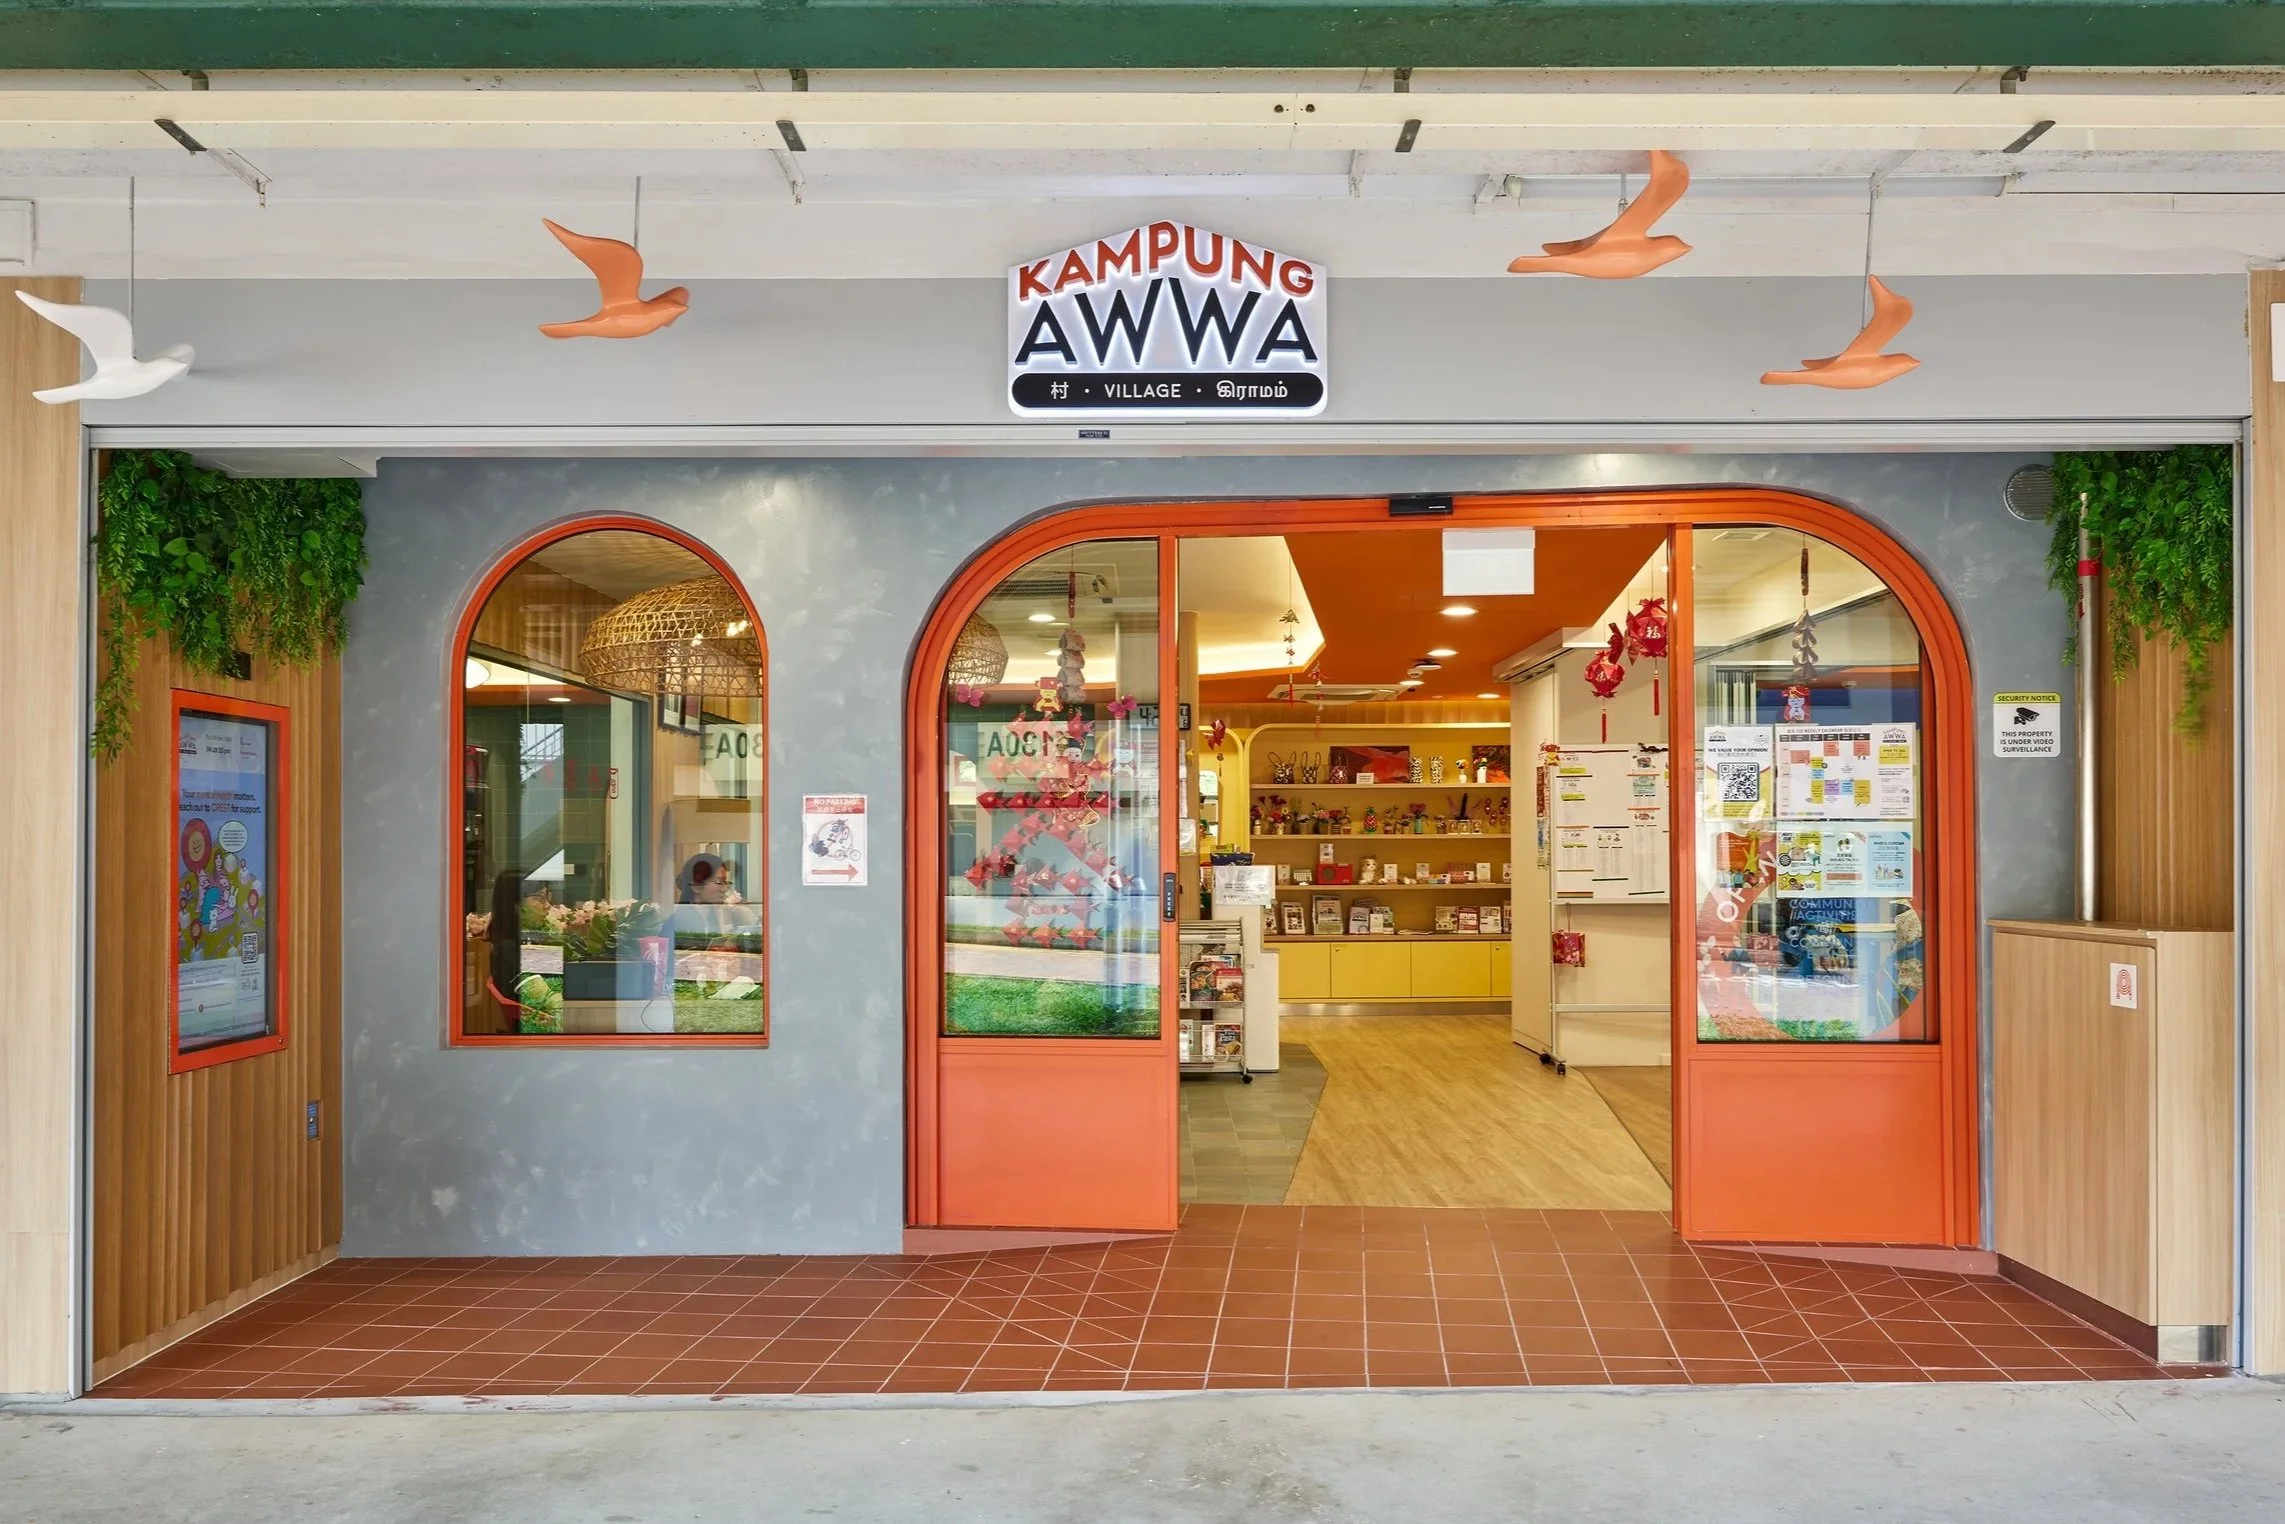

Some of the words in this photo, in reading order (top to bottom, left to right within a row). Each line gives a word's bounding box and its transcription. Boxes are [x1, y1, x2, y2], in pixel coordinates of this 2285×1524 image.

[1018, 220, 1315, 301] KAMPUNG
[1014, 277, 1318, 365] AWWA
[1051, 382, 1069, 400] 村
[1104, 383, 1182, 398] VILLAGE
[1216, 379, 1288, 401] கிராமம்
[1646, 626, 1661, 639] 福
[182, 789, 195, 800] Your
[179, 802, 193, 812] each
[231, 803, 239, 813] for
[1717, 850, 1777, 923] OPN
[1789, 898, 1865, 909] COMMUN
[1796, 910, 1859, 920] ACTIVITIE
